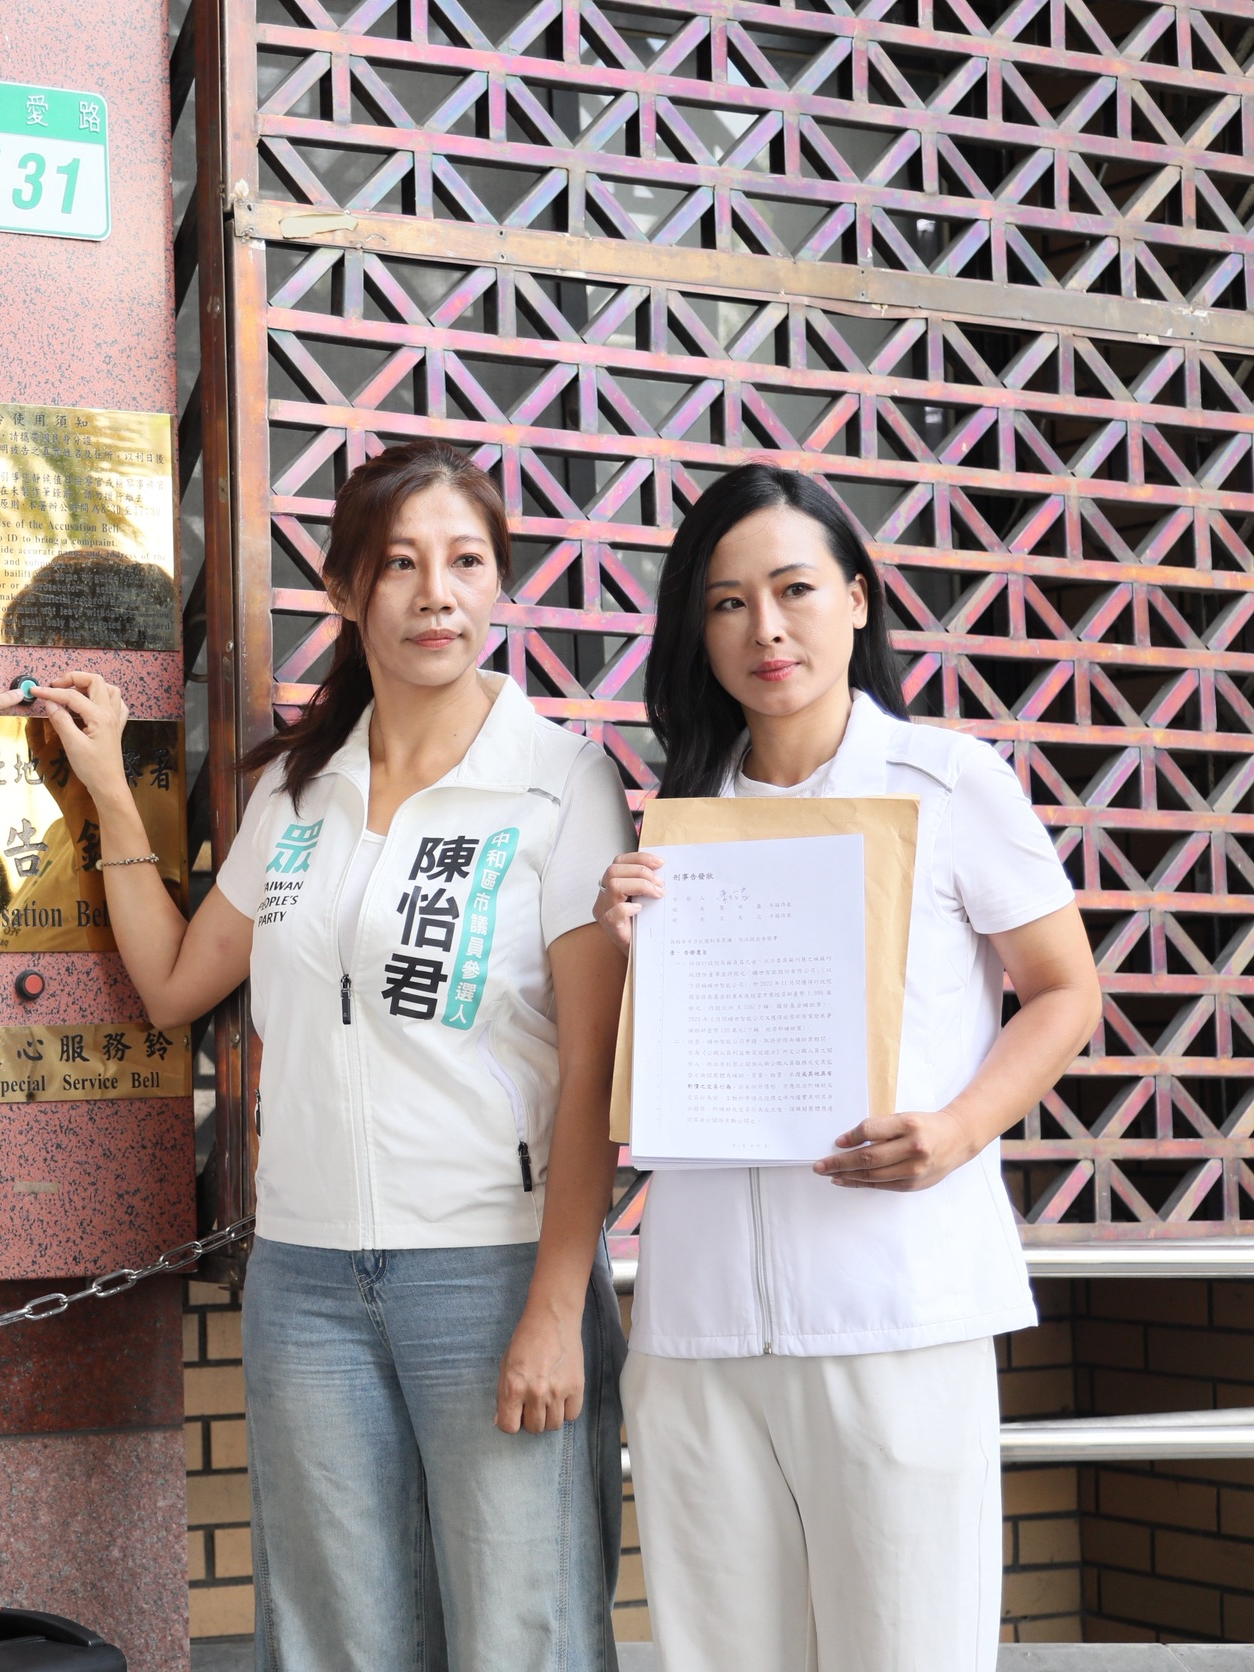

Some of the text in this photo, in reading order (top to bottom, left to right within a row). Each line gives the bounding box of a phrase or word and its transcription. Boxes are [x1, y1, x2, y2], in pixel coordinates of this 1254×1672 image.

[16, 519, 26, 528] of
[29, 519, 43, 529] the
[48, 520, 97, 532] Accusation
[102, 523, 119, 533] Bell
[7, 534, 18, 542] ID
[35, 536, 59, 546] bring
[72, 539, 118, 548] complaint.
[18, 548, 55, 556] accurate
[105, 551, 137, 560] address
[141, 552, 150, 560] of
[153, 553, 166, 561] the
[4, 558, 20, 566] and
[4, 569, 31, 578] bailiff
[264, 880, 304, 893] AIWAN
[75, 900, 111, 929] Bel
[258, 911, 287, 928] PARTY
[381, 835, 480, 1021] 陳怡君
[448, 831, 510, 1025] 中和區市議員參選人
[63, 1072, 119, 1091] Service
[131, 1071, 160, 1089] Bell
